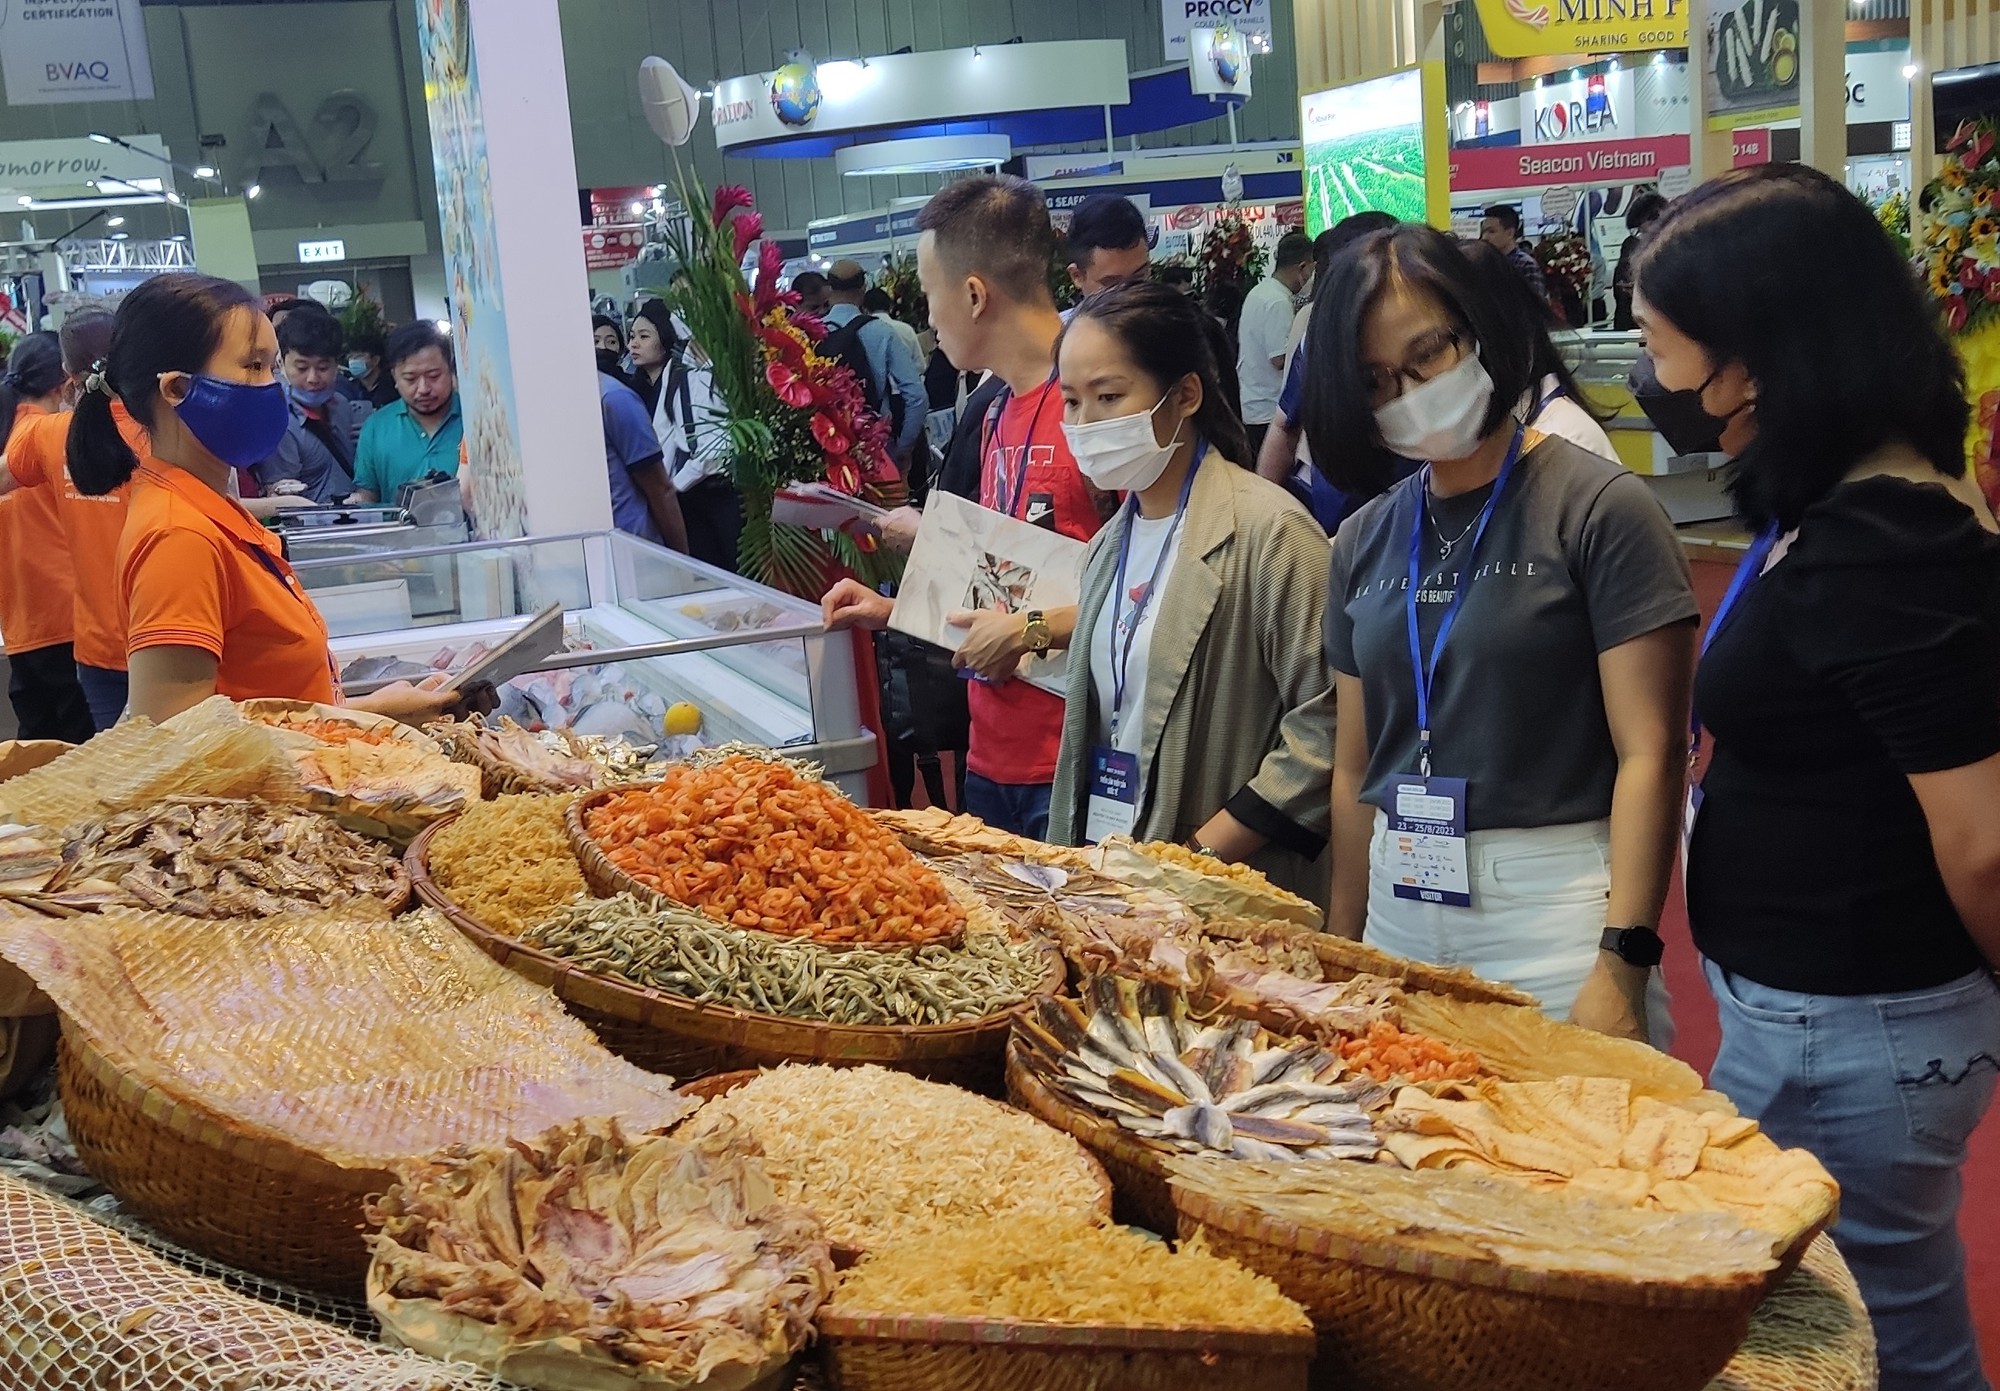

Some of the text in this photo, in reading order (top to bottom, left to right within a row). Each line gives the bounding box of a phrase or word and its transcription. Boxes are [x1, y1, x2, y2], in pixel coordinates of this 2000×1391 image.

[23, 8, 113, 20] CERTIFICATION
[1575, 34, 1628, 47] SHARING
[1638, 31, 1674, 43] GOOD
[45, 61, 109, 81] BVAQ
[1535, 92, 1619, 140] KOREA
[246, 92, 384, 184] A2
[1519, 151, 1656, 176] Seacon Vietnam
[303, 245, 339, 258] EXIT
[1397, 822, 1407, 831] 23
[1414, 823, 1455, 836] 25/8/2023
